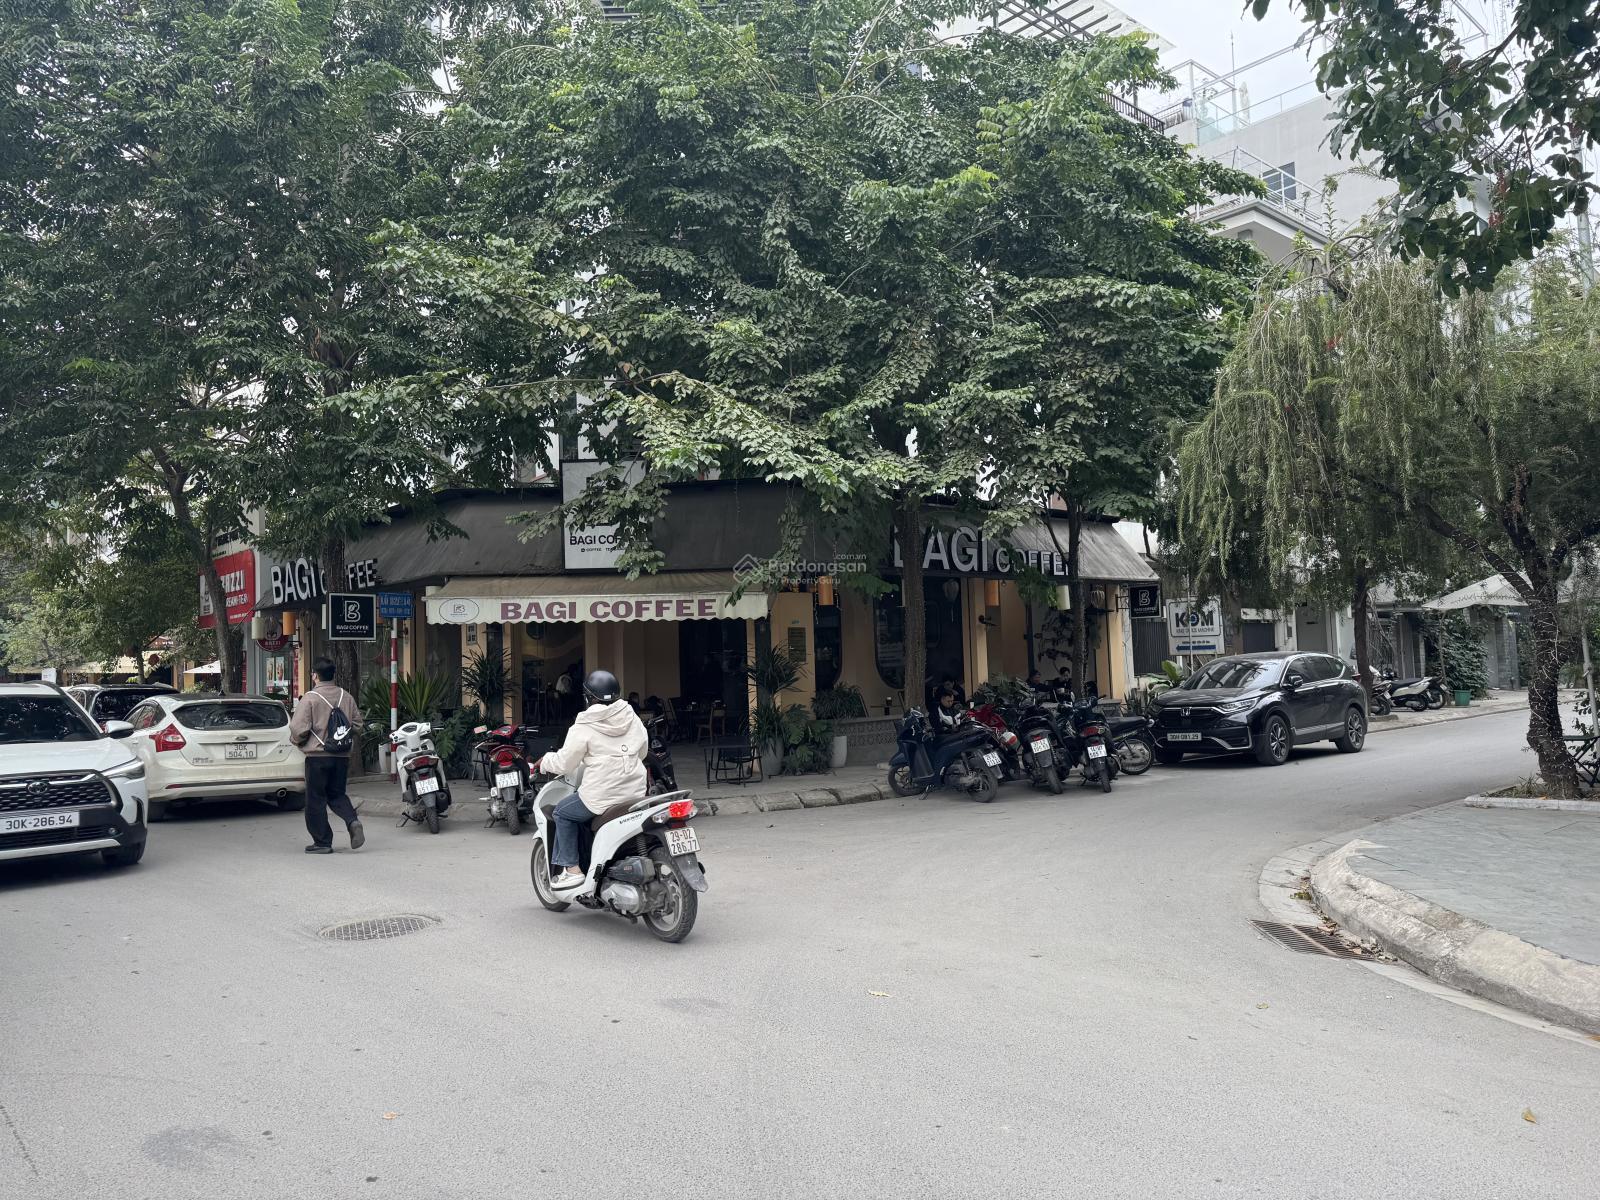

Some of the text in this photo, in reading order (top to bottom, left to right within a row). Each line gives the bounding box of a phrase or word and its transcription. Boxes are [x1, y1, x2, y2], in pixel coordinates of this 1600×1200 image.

[570, 535, 597, 546] BAGI
[995, 546, 1069, 577] COFFE
[500, 598, 716, 620] BAGI COFFEE
[5, 815, 73, 830] 30K-286.94
[669, 828, 693, 843] 29-D2
[671, 839, 697, 855] 286.77
